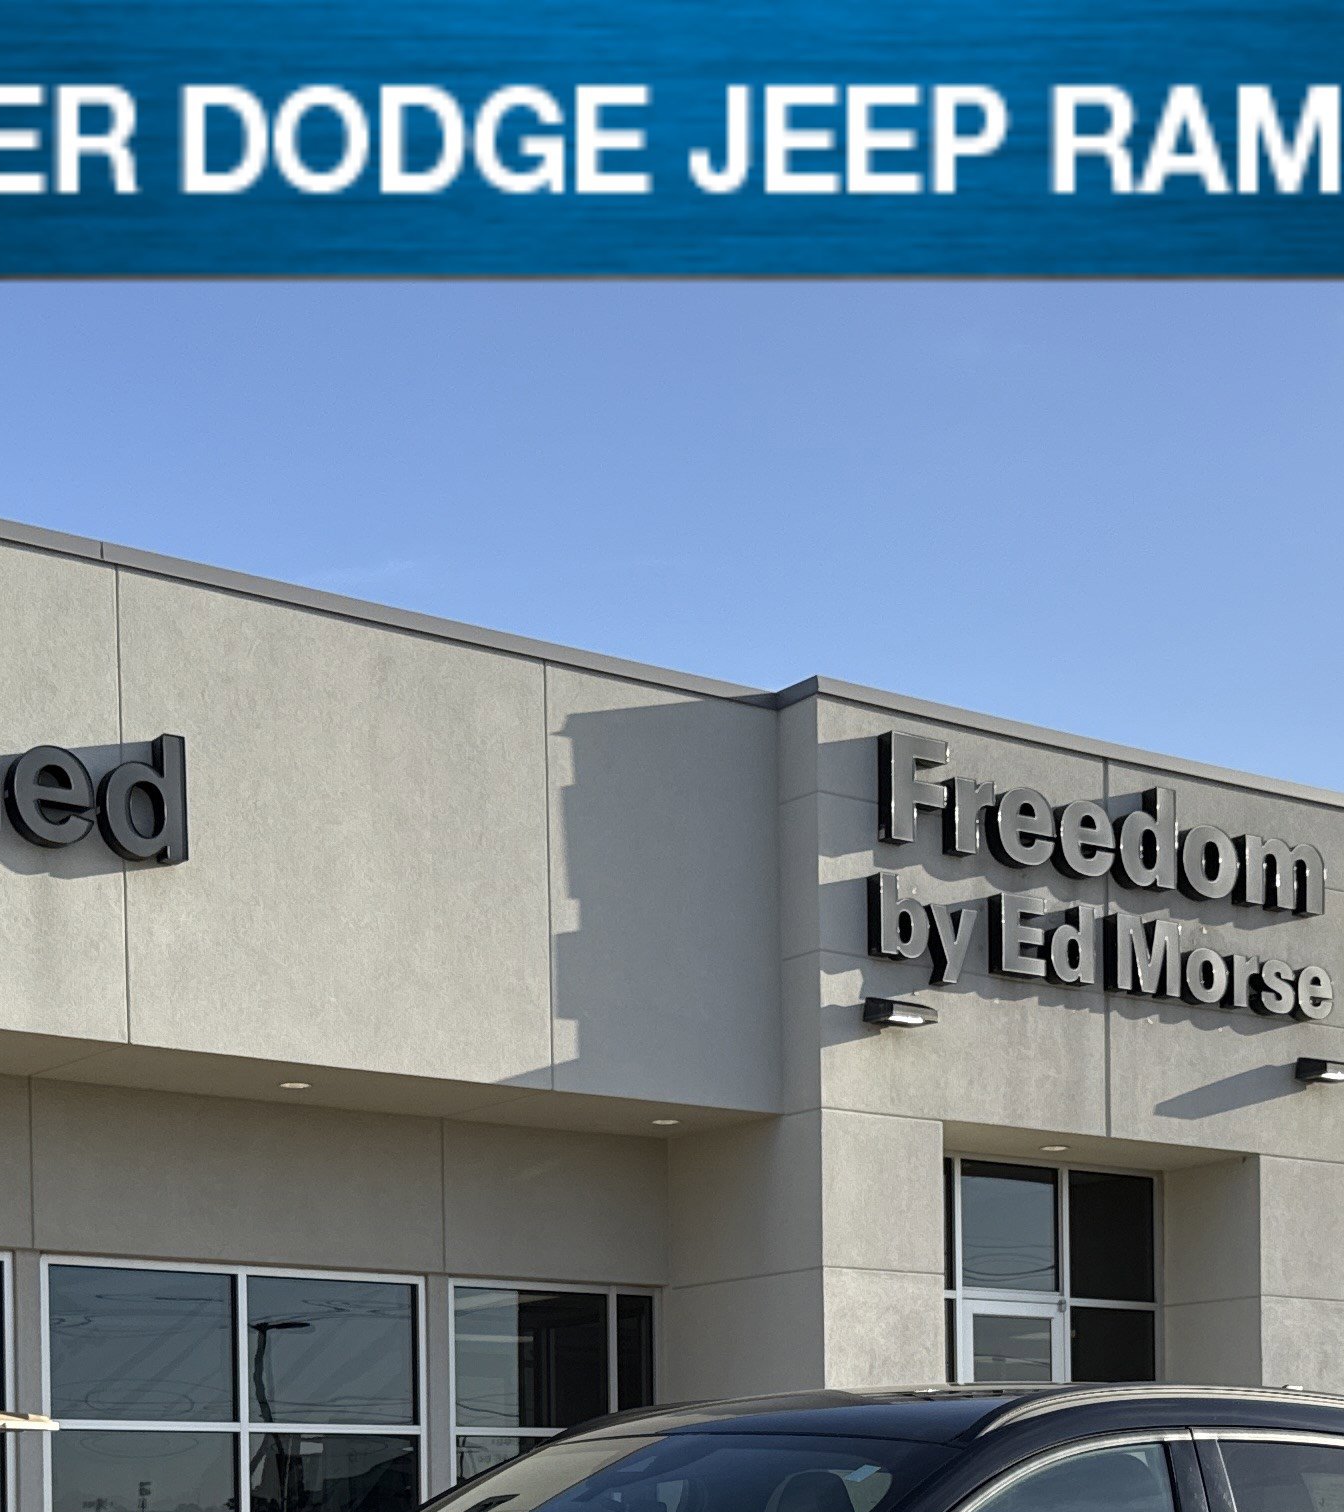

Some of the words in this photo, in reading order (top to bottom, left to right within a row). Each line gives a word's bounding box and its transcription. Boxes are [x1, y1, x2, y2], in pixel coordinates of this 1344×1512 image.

[878, 730, 1326, 916] Freedom
[868, 871, 977, 985] by
[988, 893, 1096, 985] Ed
[1104, 912, 1334, 1020] Morse
